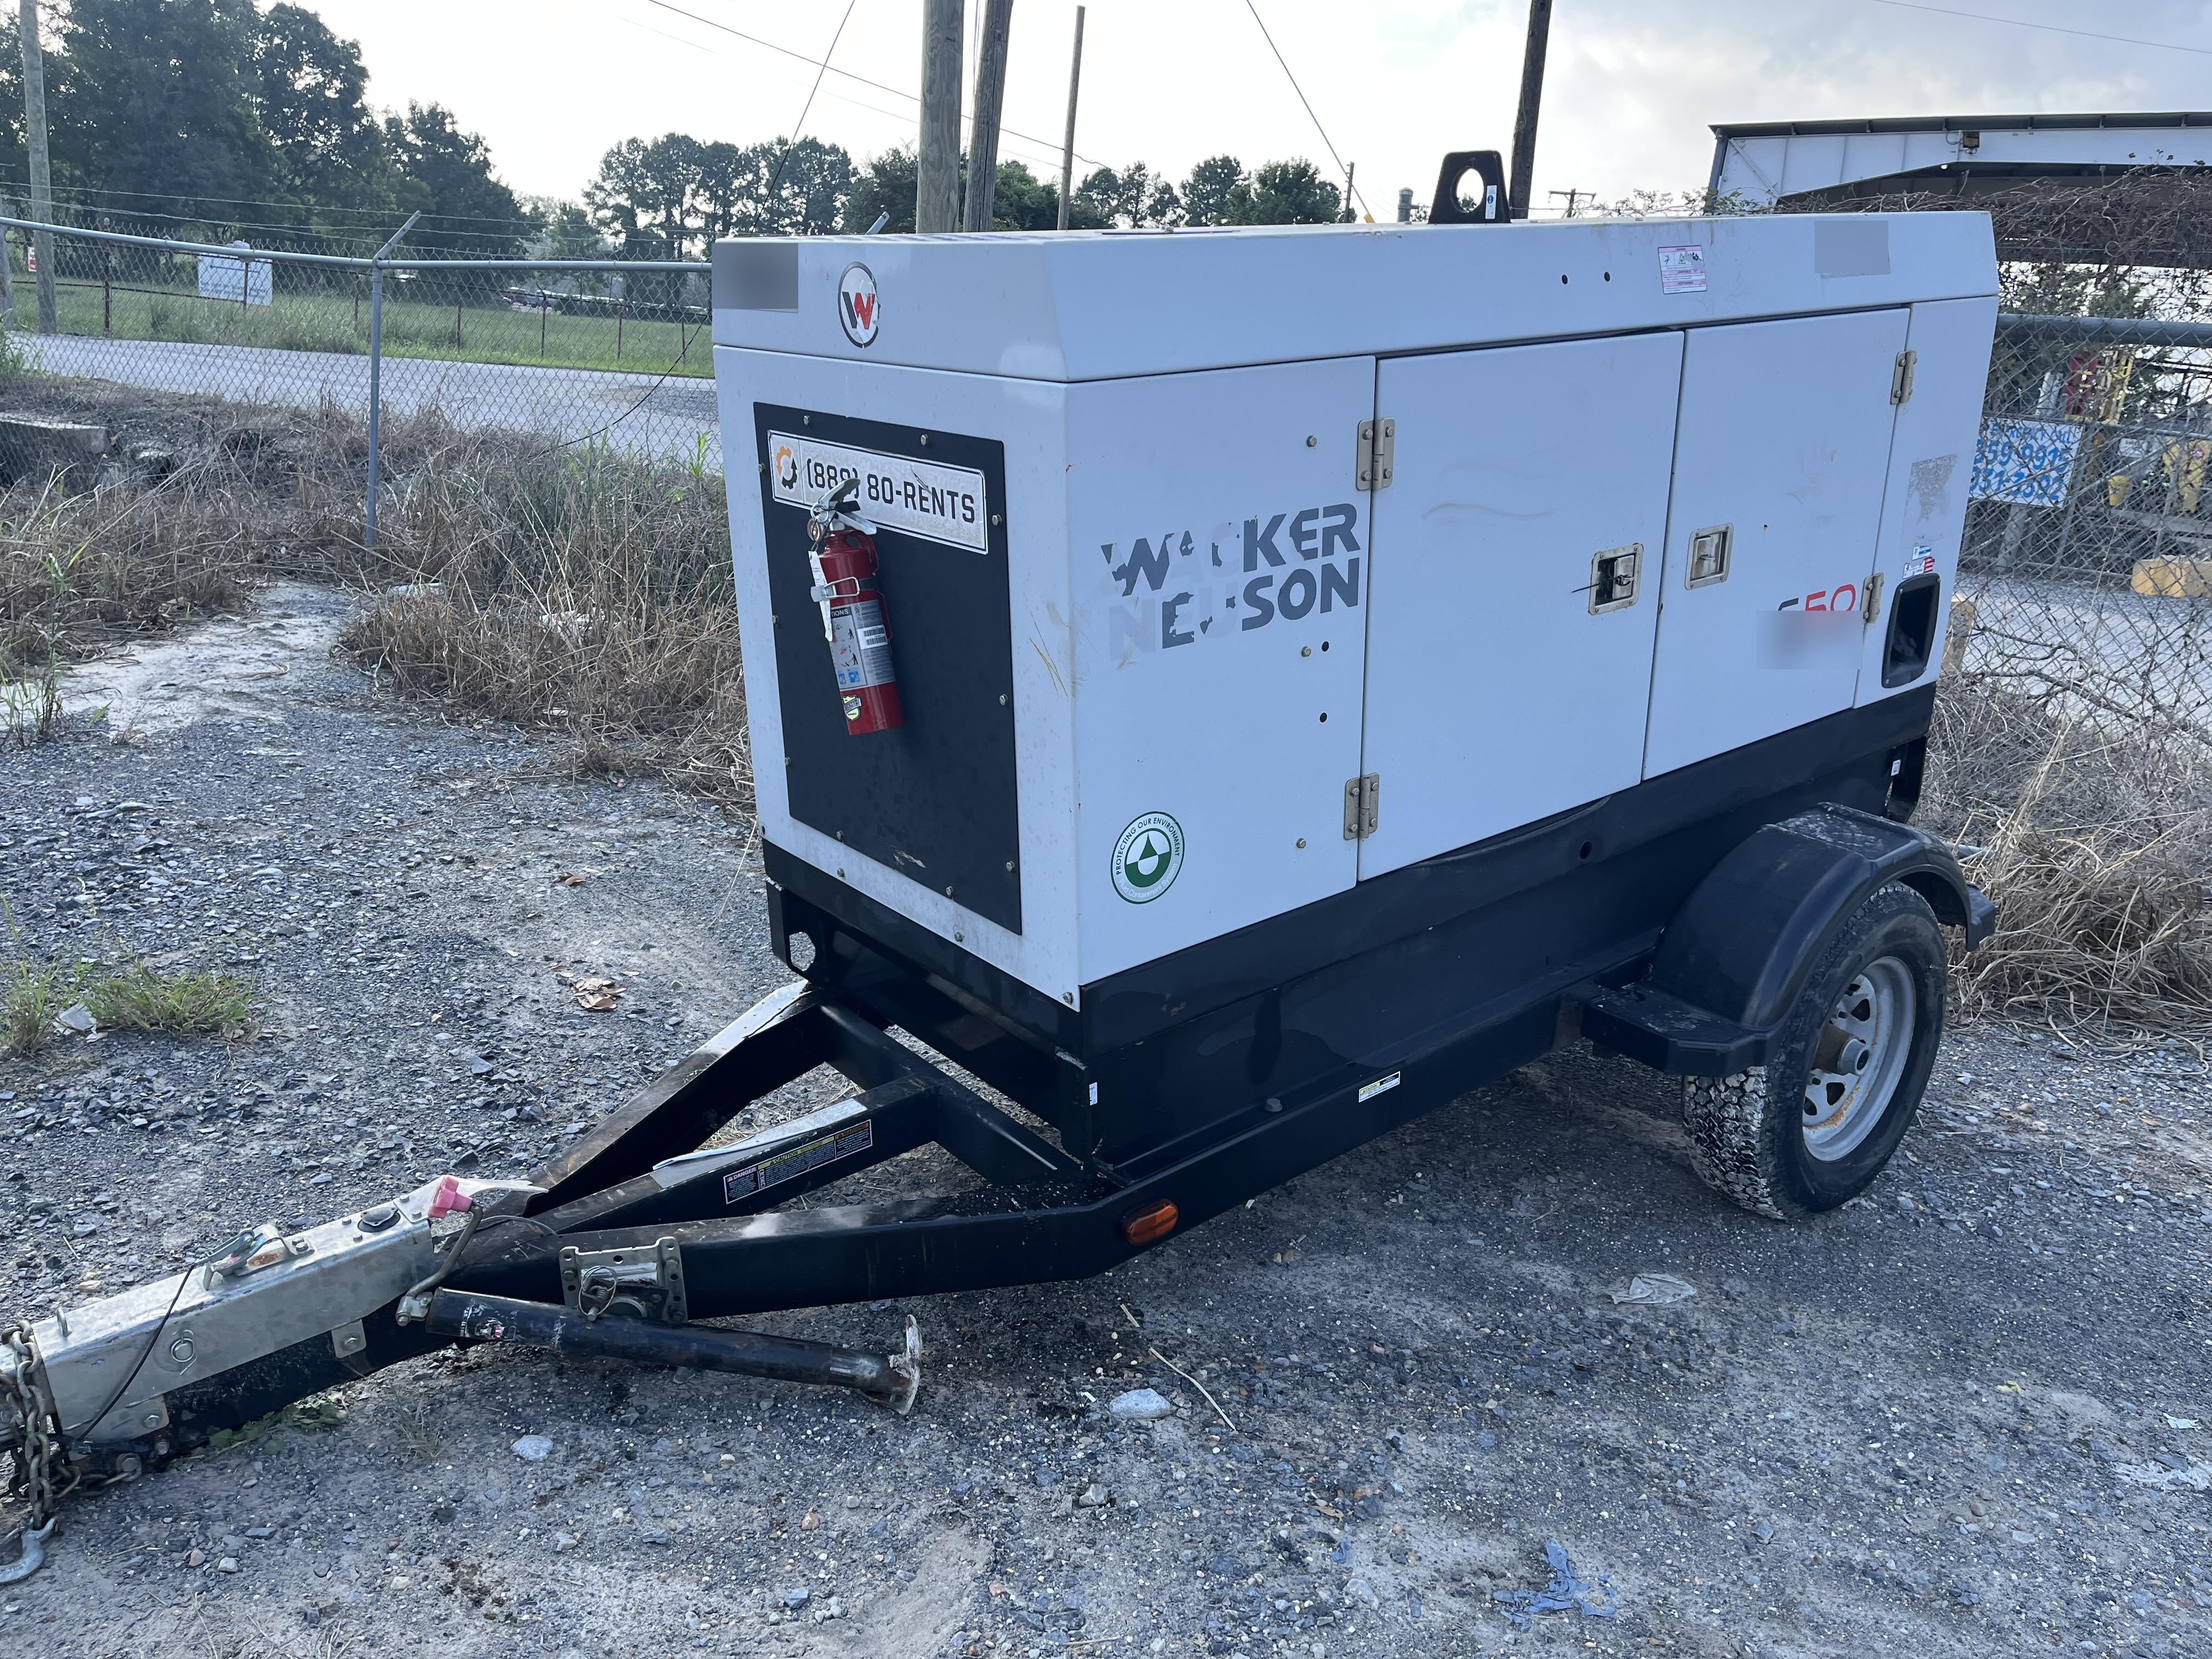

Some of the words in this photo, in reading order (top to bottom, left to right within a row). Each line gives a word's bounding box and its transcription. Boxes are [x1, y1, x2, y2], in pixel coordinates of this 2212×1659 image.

[867, 474, 975, 523] 80-RENTS
[1116, 827, 1136, 875] PROTECTING
[1138, 818, 1152, 828] OUR
[1153, 817, 1180, 856] ENVIRONMENT
[1119, 878, 1128, 893] Fluid
[1128, 884, 1162, 899] Containment
[1161, 863, 1178, 888] System
[733, 1167, 757, 1180] DANGER
[775, 1150, 798, 1163] CAUTION
